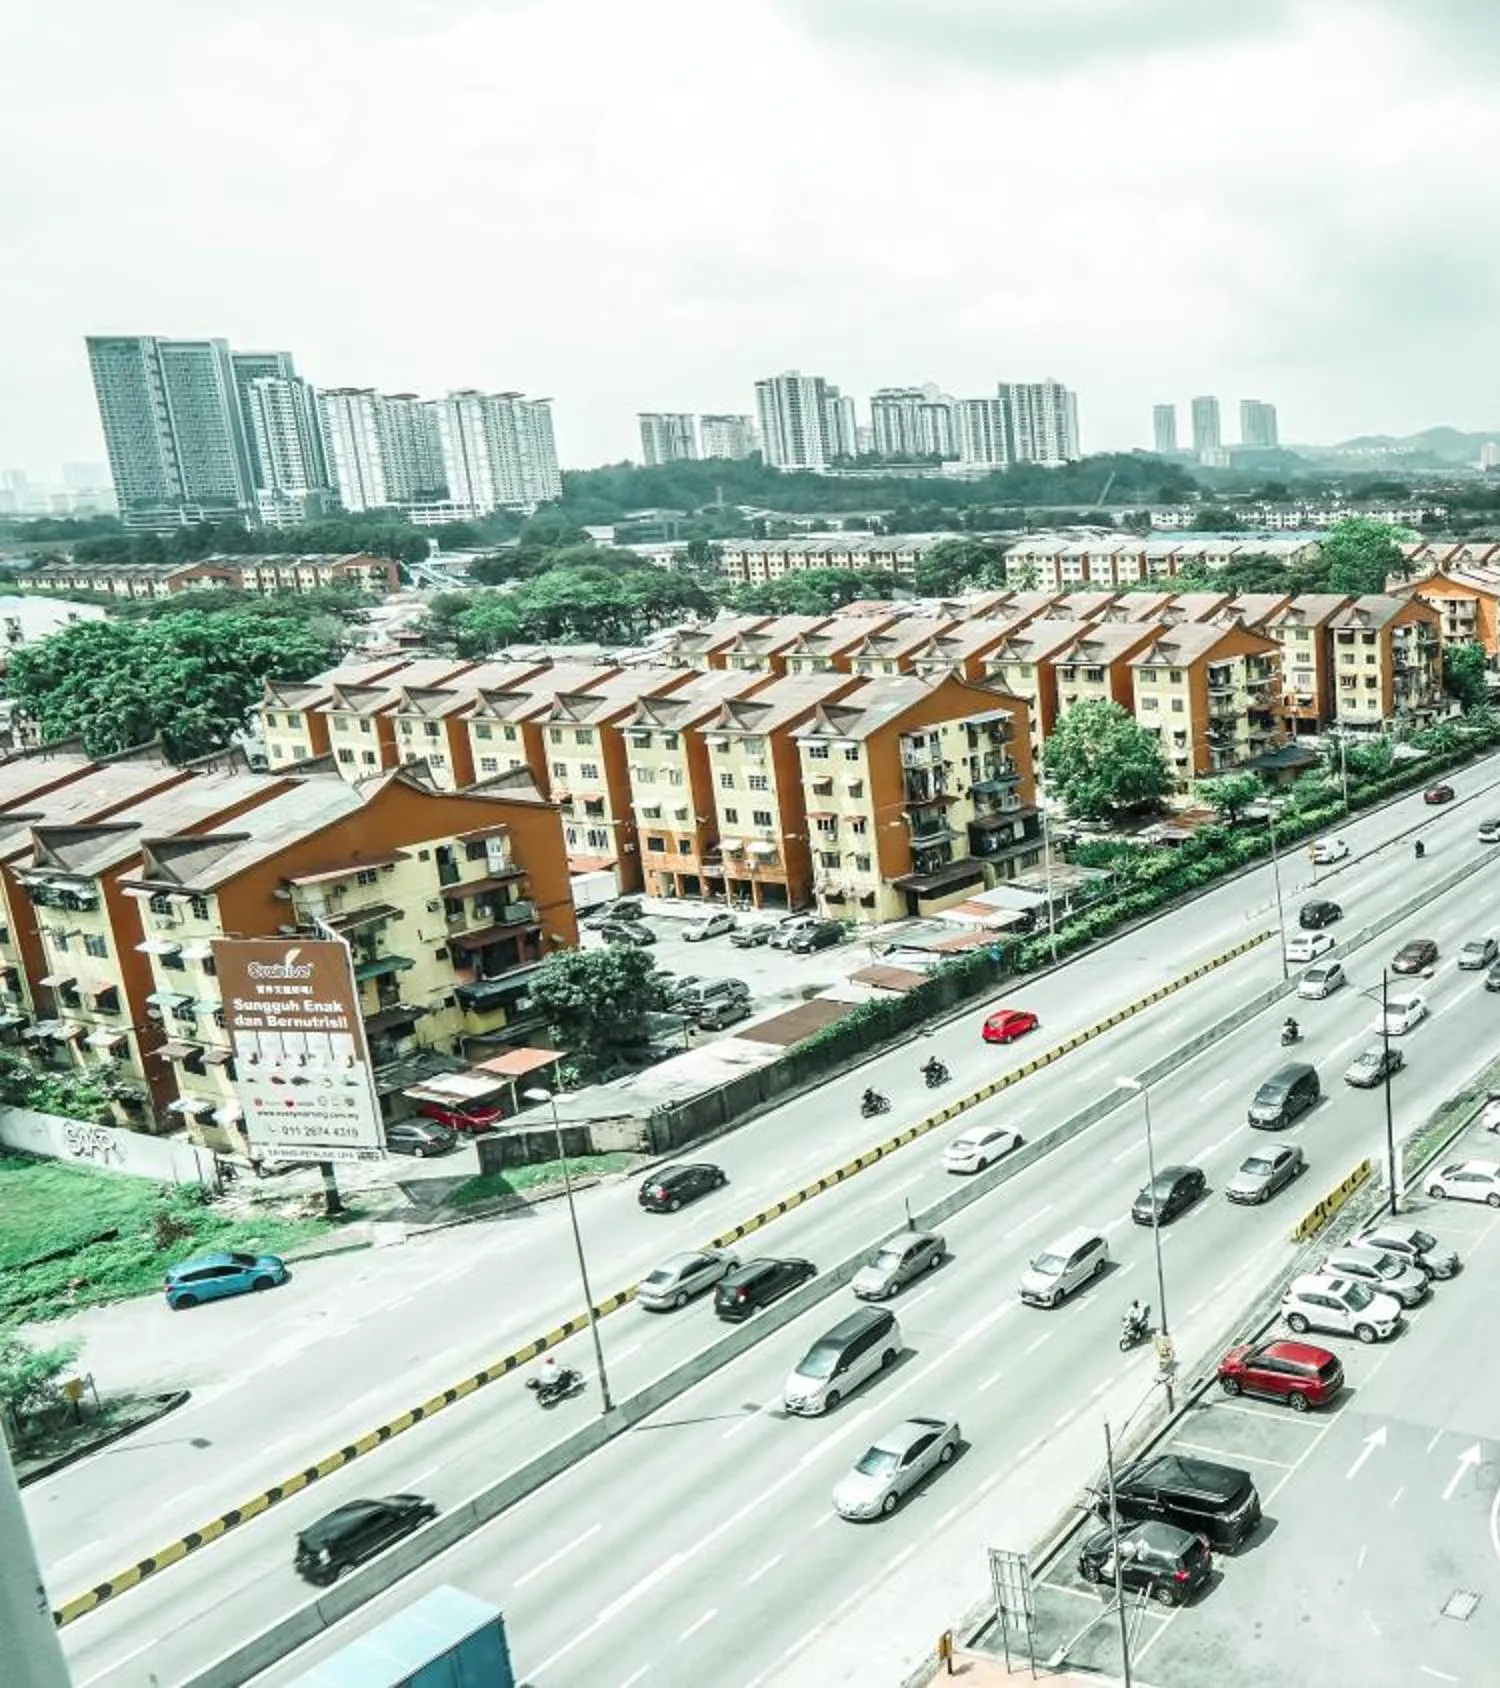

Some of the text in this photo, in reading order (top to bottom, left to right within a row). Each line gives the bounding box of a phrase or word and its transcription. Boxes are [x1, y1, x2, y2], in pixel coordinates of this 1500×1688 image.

[233, 998, 343, 1014] Sungguh Enak
[234, 1014, 263, 1027] dan
